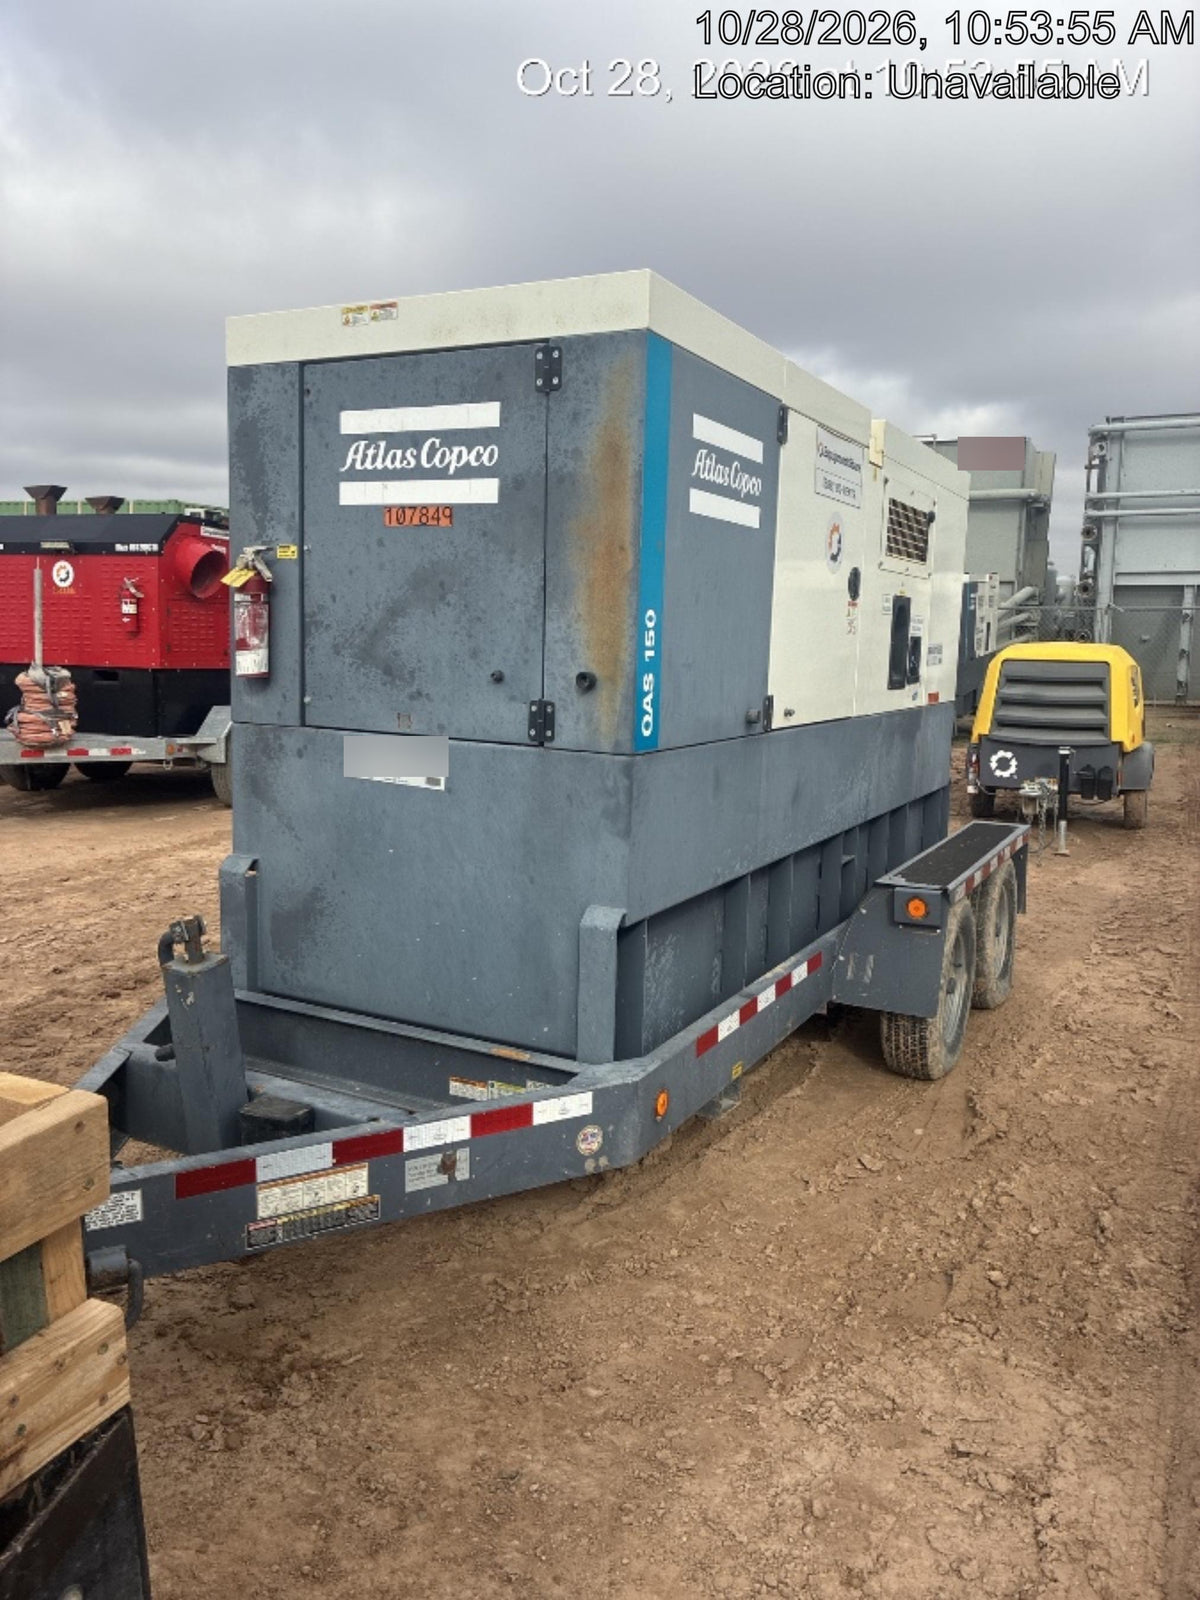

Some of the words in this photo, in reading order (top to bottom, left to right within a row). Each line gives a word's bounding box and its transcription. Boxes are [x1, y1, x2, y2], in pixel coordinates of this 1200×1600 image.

[339, 440, 417, 472] Atlas
[420, 437, 499, 475] Copco
[691, 449, 730, 486] Atlas
[730, 461, 762, 498] Copco
[386, 507, 452, 526] 107849
[644, 609, 656, 662] 150
[641, 673, 655, 737] QAS
